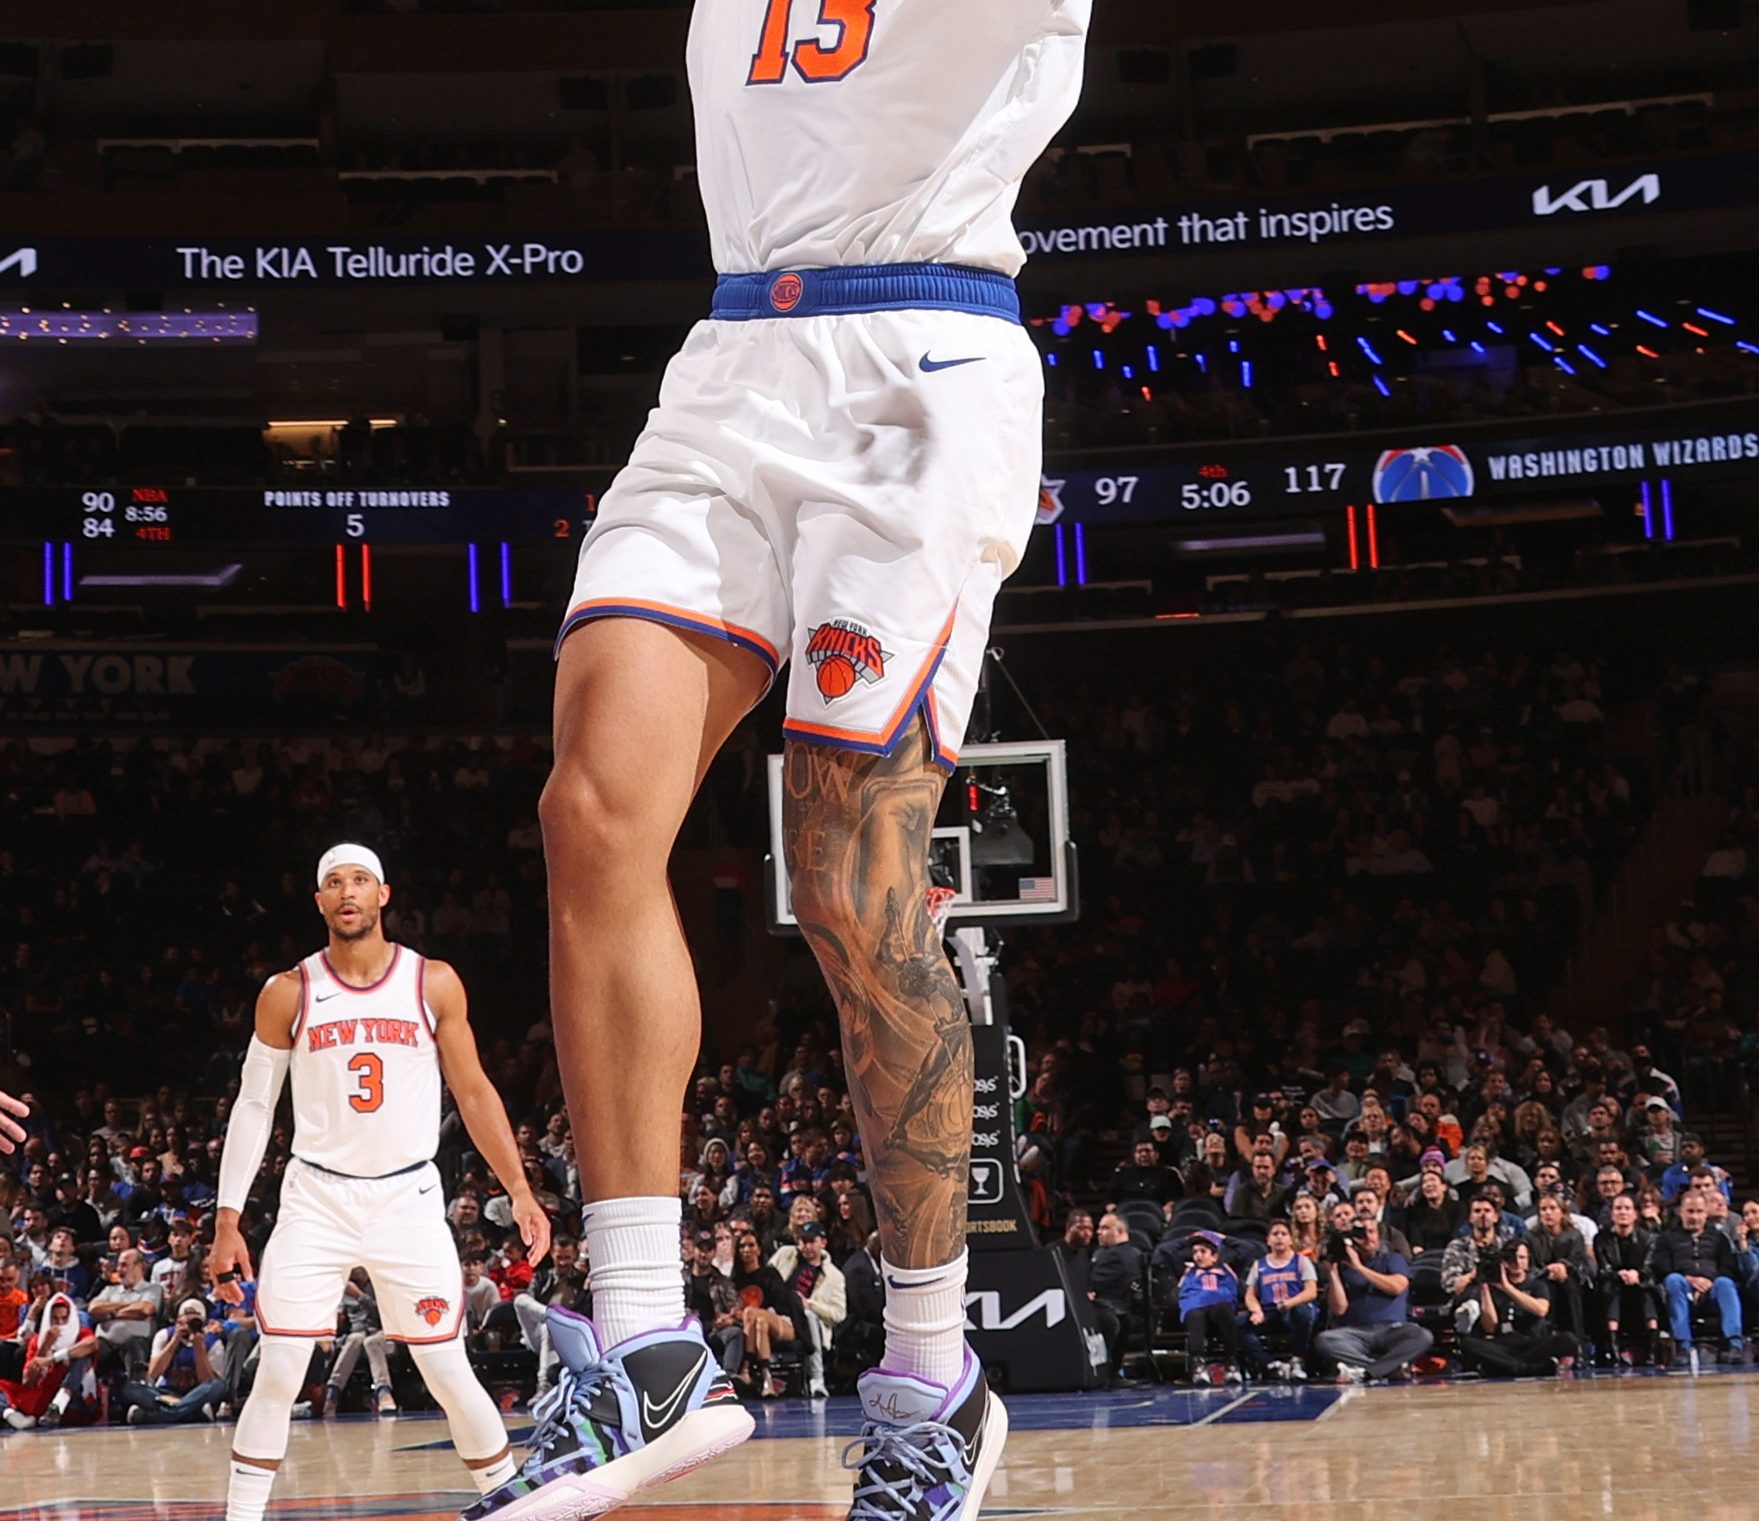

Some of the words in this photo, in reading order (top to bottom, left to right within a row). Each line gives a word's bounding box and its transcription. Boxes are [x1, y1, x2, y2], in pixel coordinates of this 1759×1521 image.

[1021, 217, 1168, 254] ovement
[1177, 211, 1249, 244] that
[1259, 203, 1394, 243] inspires
[177, 247, 244, 279] The
[255, 247, 317, 279] KIA
[327, 246, 475, 278] Telluride
[485, 243, 584, 275] X-Pro
[1488, 444, 1645, 480] WASHINGTON
[1653, 433, 1759, 467] WIZARDS
[1094, 476, 1139, 505] 97
[1284, 463, 1347, 494] 117
[82, 492, 115, 513] 90
[132, 487, 168, 503] NBA
[264, 491, 322, 507] POINTS
[326, 491, 354, 507] OFF
[358, 491, 450, 507] TURNOVERS
[1180, 480, 1251, 510] 5:06
[82, 517, 115, 538] 84
[125, 506, 168, 522] 8:56
[346, 514, 364, 537] 5
[554, 517, 571, 537] 2
[805, 622, 884, 679] KNICKS
[60, 654, 196, 695] YORK
[307, 1019, 358, 1053] NEW
[361, 1017, 419, 1049] YORK
[347, 1052, 384, 1114] 3
